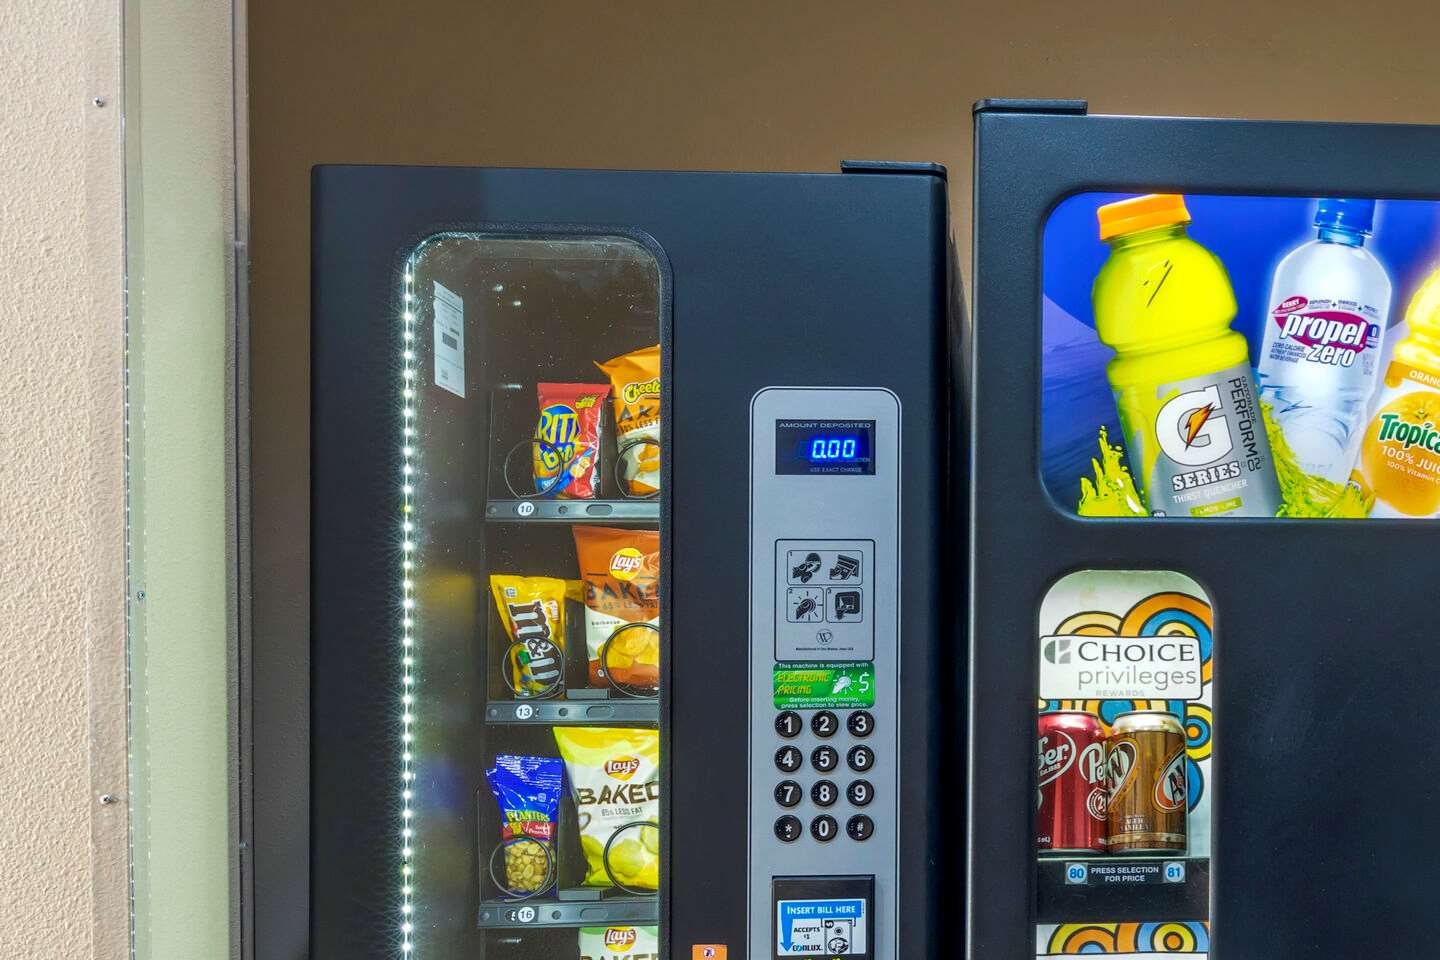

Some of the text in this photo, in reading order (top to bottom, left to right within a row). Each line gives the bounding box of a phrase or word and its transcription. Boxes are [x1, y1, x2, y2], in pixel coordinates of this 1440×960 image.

[1280, 314, 1367, 346] propel
[1306, 343, 1357, 367] zero
[1155, 384, 1233, 466] G
[1228, 377, 1258, 459] PERFORM
[537, 412, 579, 443] RITZ
[812, 439, 856, 458] 0.00
[1382, 445, 1415, 465] 100%
[1171, 461, 1241, 492] SERIES
[520, 505, 531, 513] 10
[611, 555, 642, 572] Lay's
[1078, 641, 1195, 662] CHOICE
[858, 672, 870, 694] $
[1078, 665, 1197, 690] privileges
[518, 707, 531, 716] 13
[784, 716, 867, 733] 1 2 3
[608, 758, 640, 775] Lay's
[782, 750, 866, 767] 4 5 6
[783, 785, 866, 802] 7 8 9
[819, 820, 829, 837] 0
[1069, 868, 1084, 879] 80
[1168, 866, 1180, 877] 81
[520, 908, 533, 921] 16
[787, 905, 855, 915] INSERT BILL HERE
[606, 929, 635, 946] Lay's
